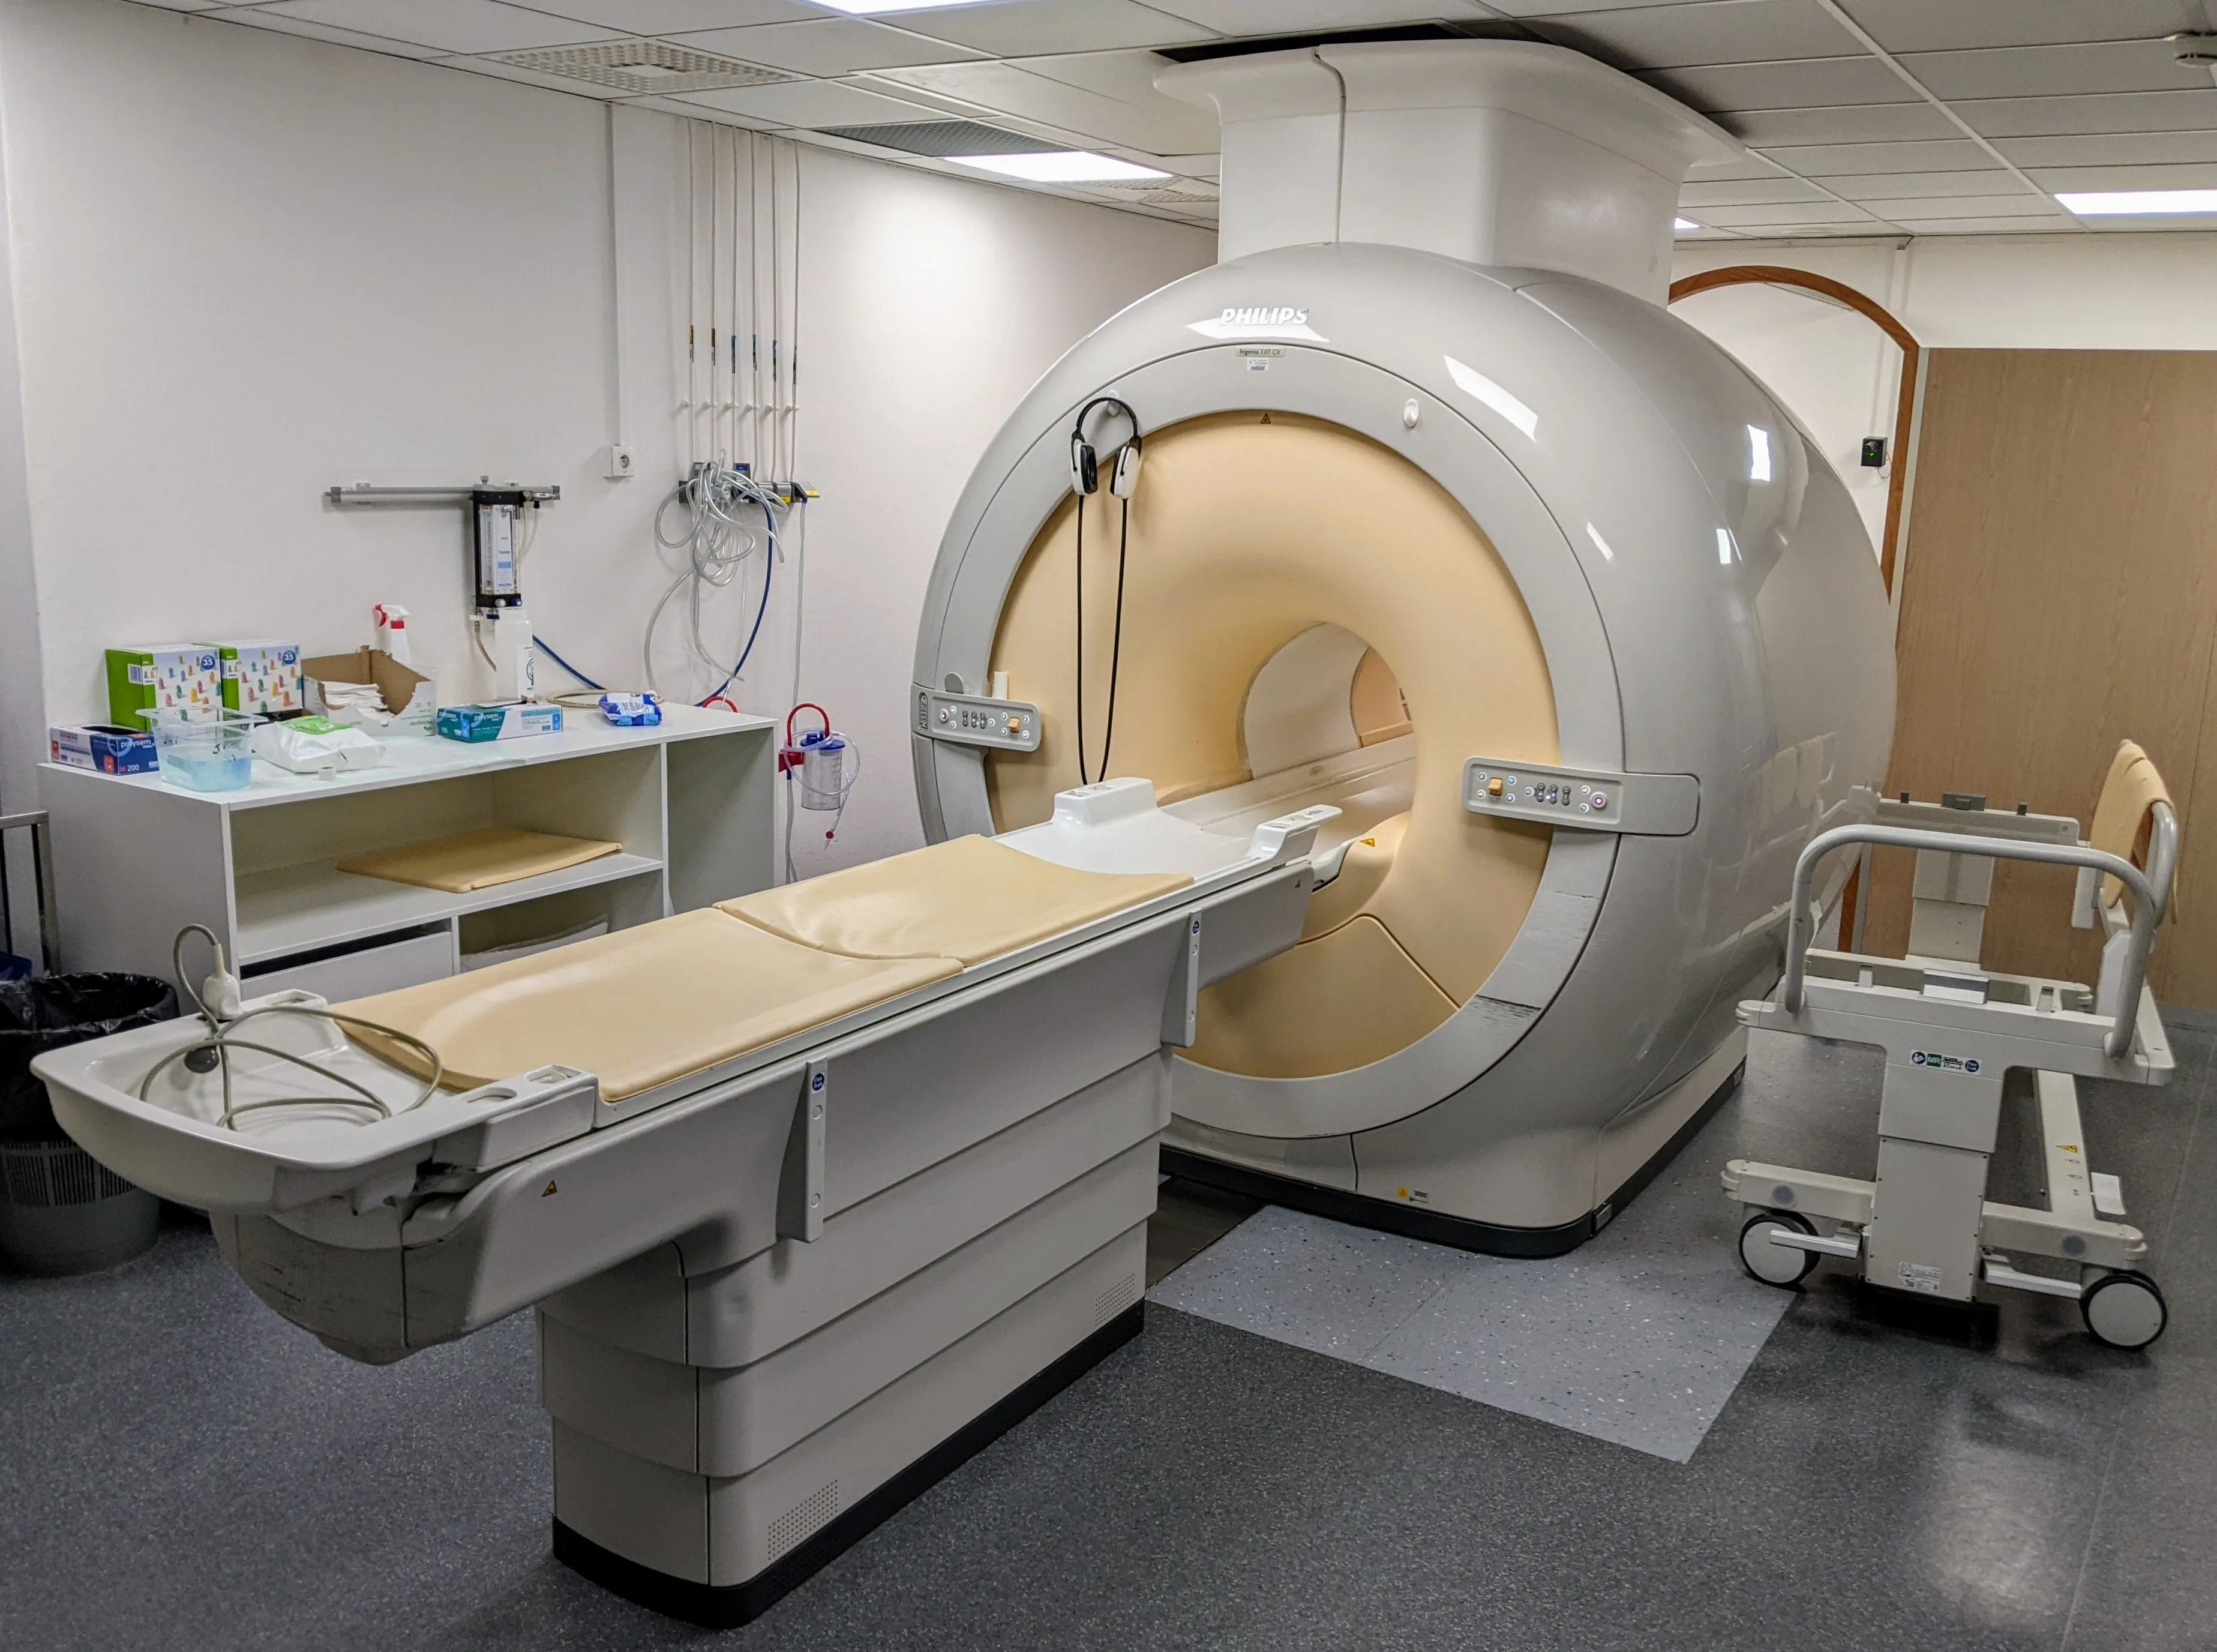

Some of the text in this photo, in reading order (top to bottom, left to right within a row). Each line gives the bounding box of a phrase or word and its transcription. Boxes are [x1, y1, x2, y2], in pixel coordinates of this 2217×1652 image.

[1220, 307, 1309, 326] PHILIPS
[1239, 348, 1259, 356] Ingenia
[121, 739, 151, 748] polysem
